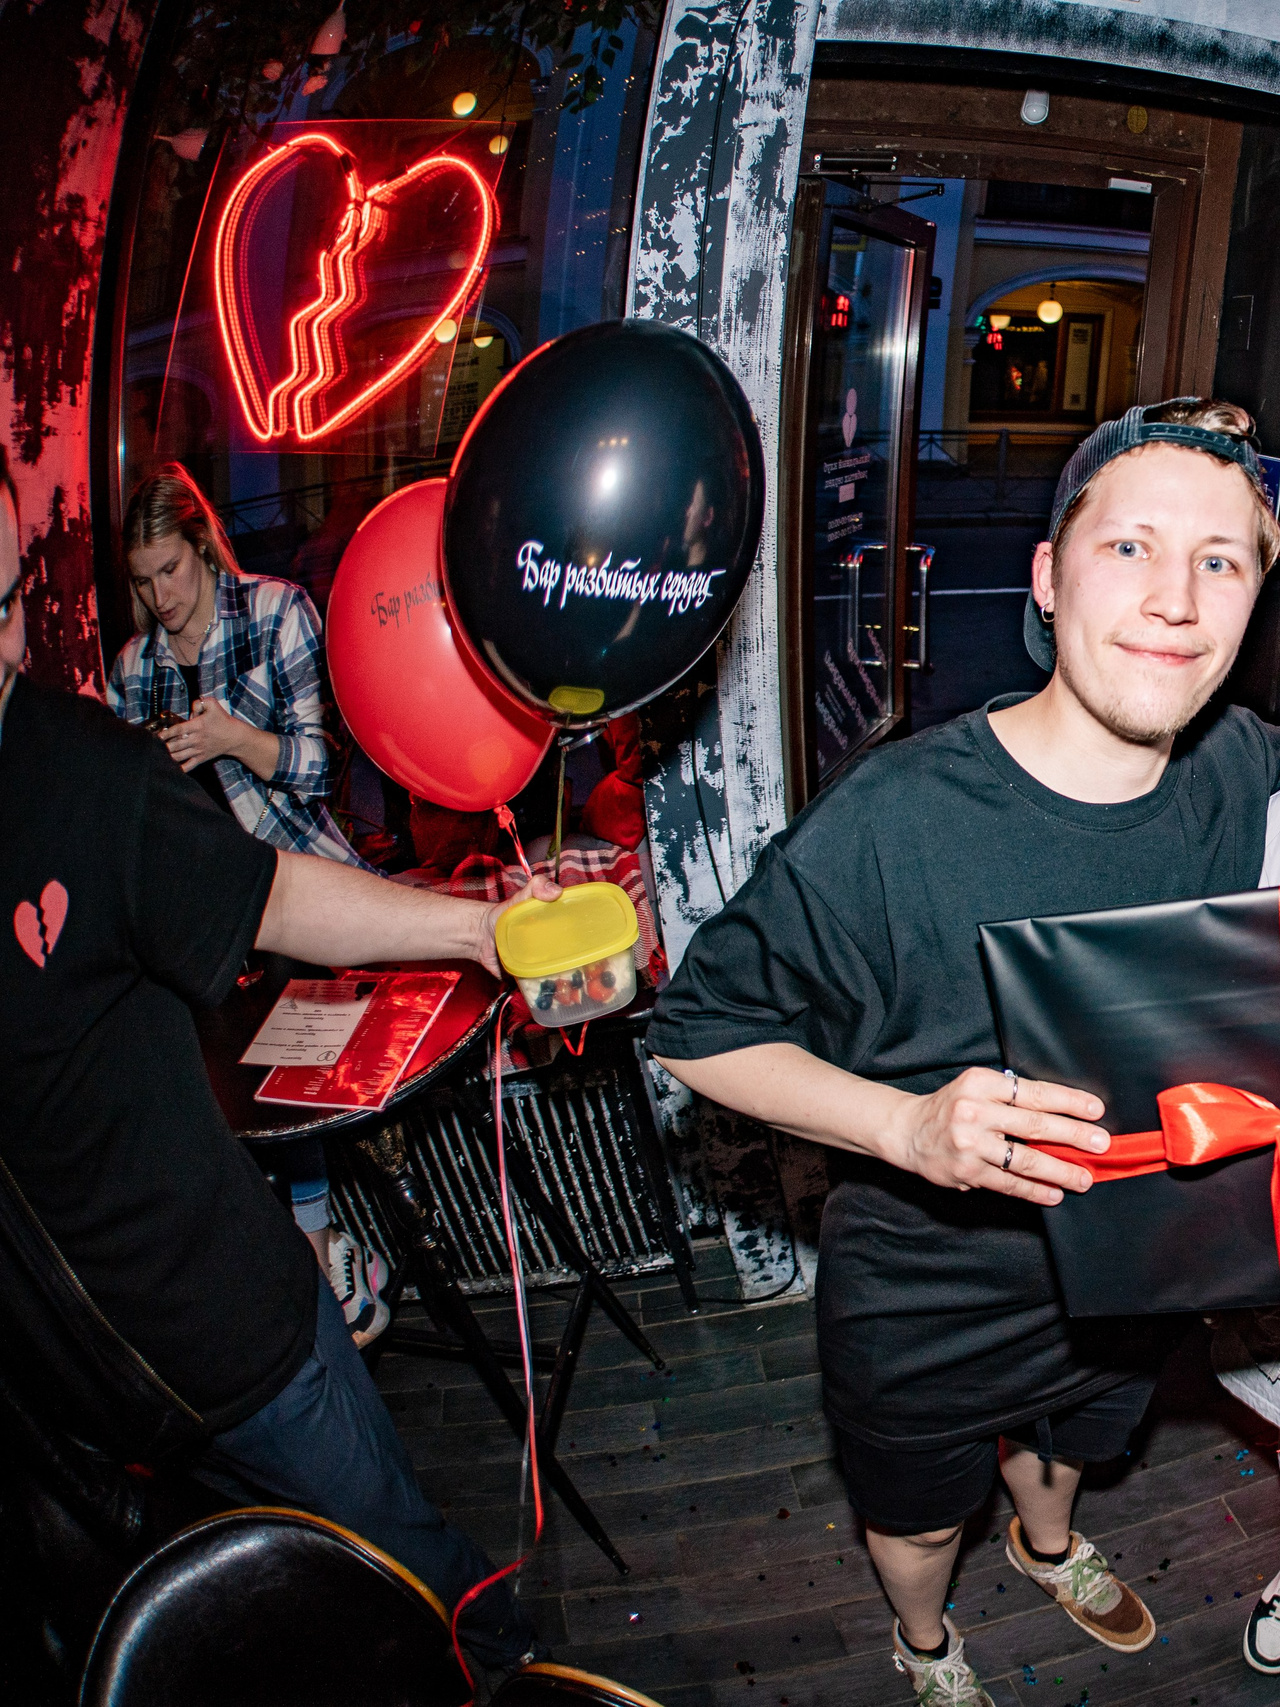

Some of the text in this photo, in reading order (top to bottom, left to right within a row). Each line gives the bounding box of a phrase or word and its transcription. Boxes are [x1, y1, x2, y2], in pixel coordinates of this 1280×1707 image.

[370, 571, 441, 629] Бар разби
[516, 540, 726, 617] Бар разбитых сердец
